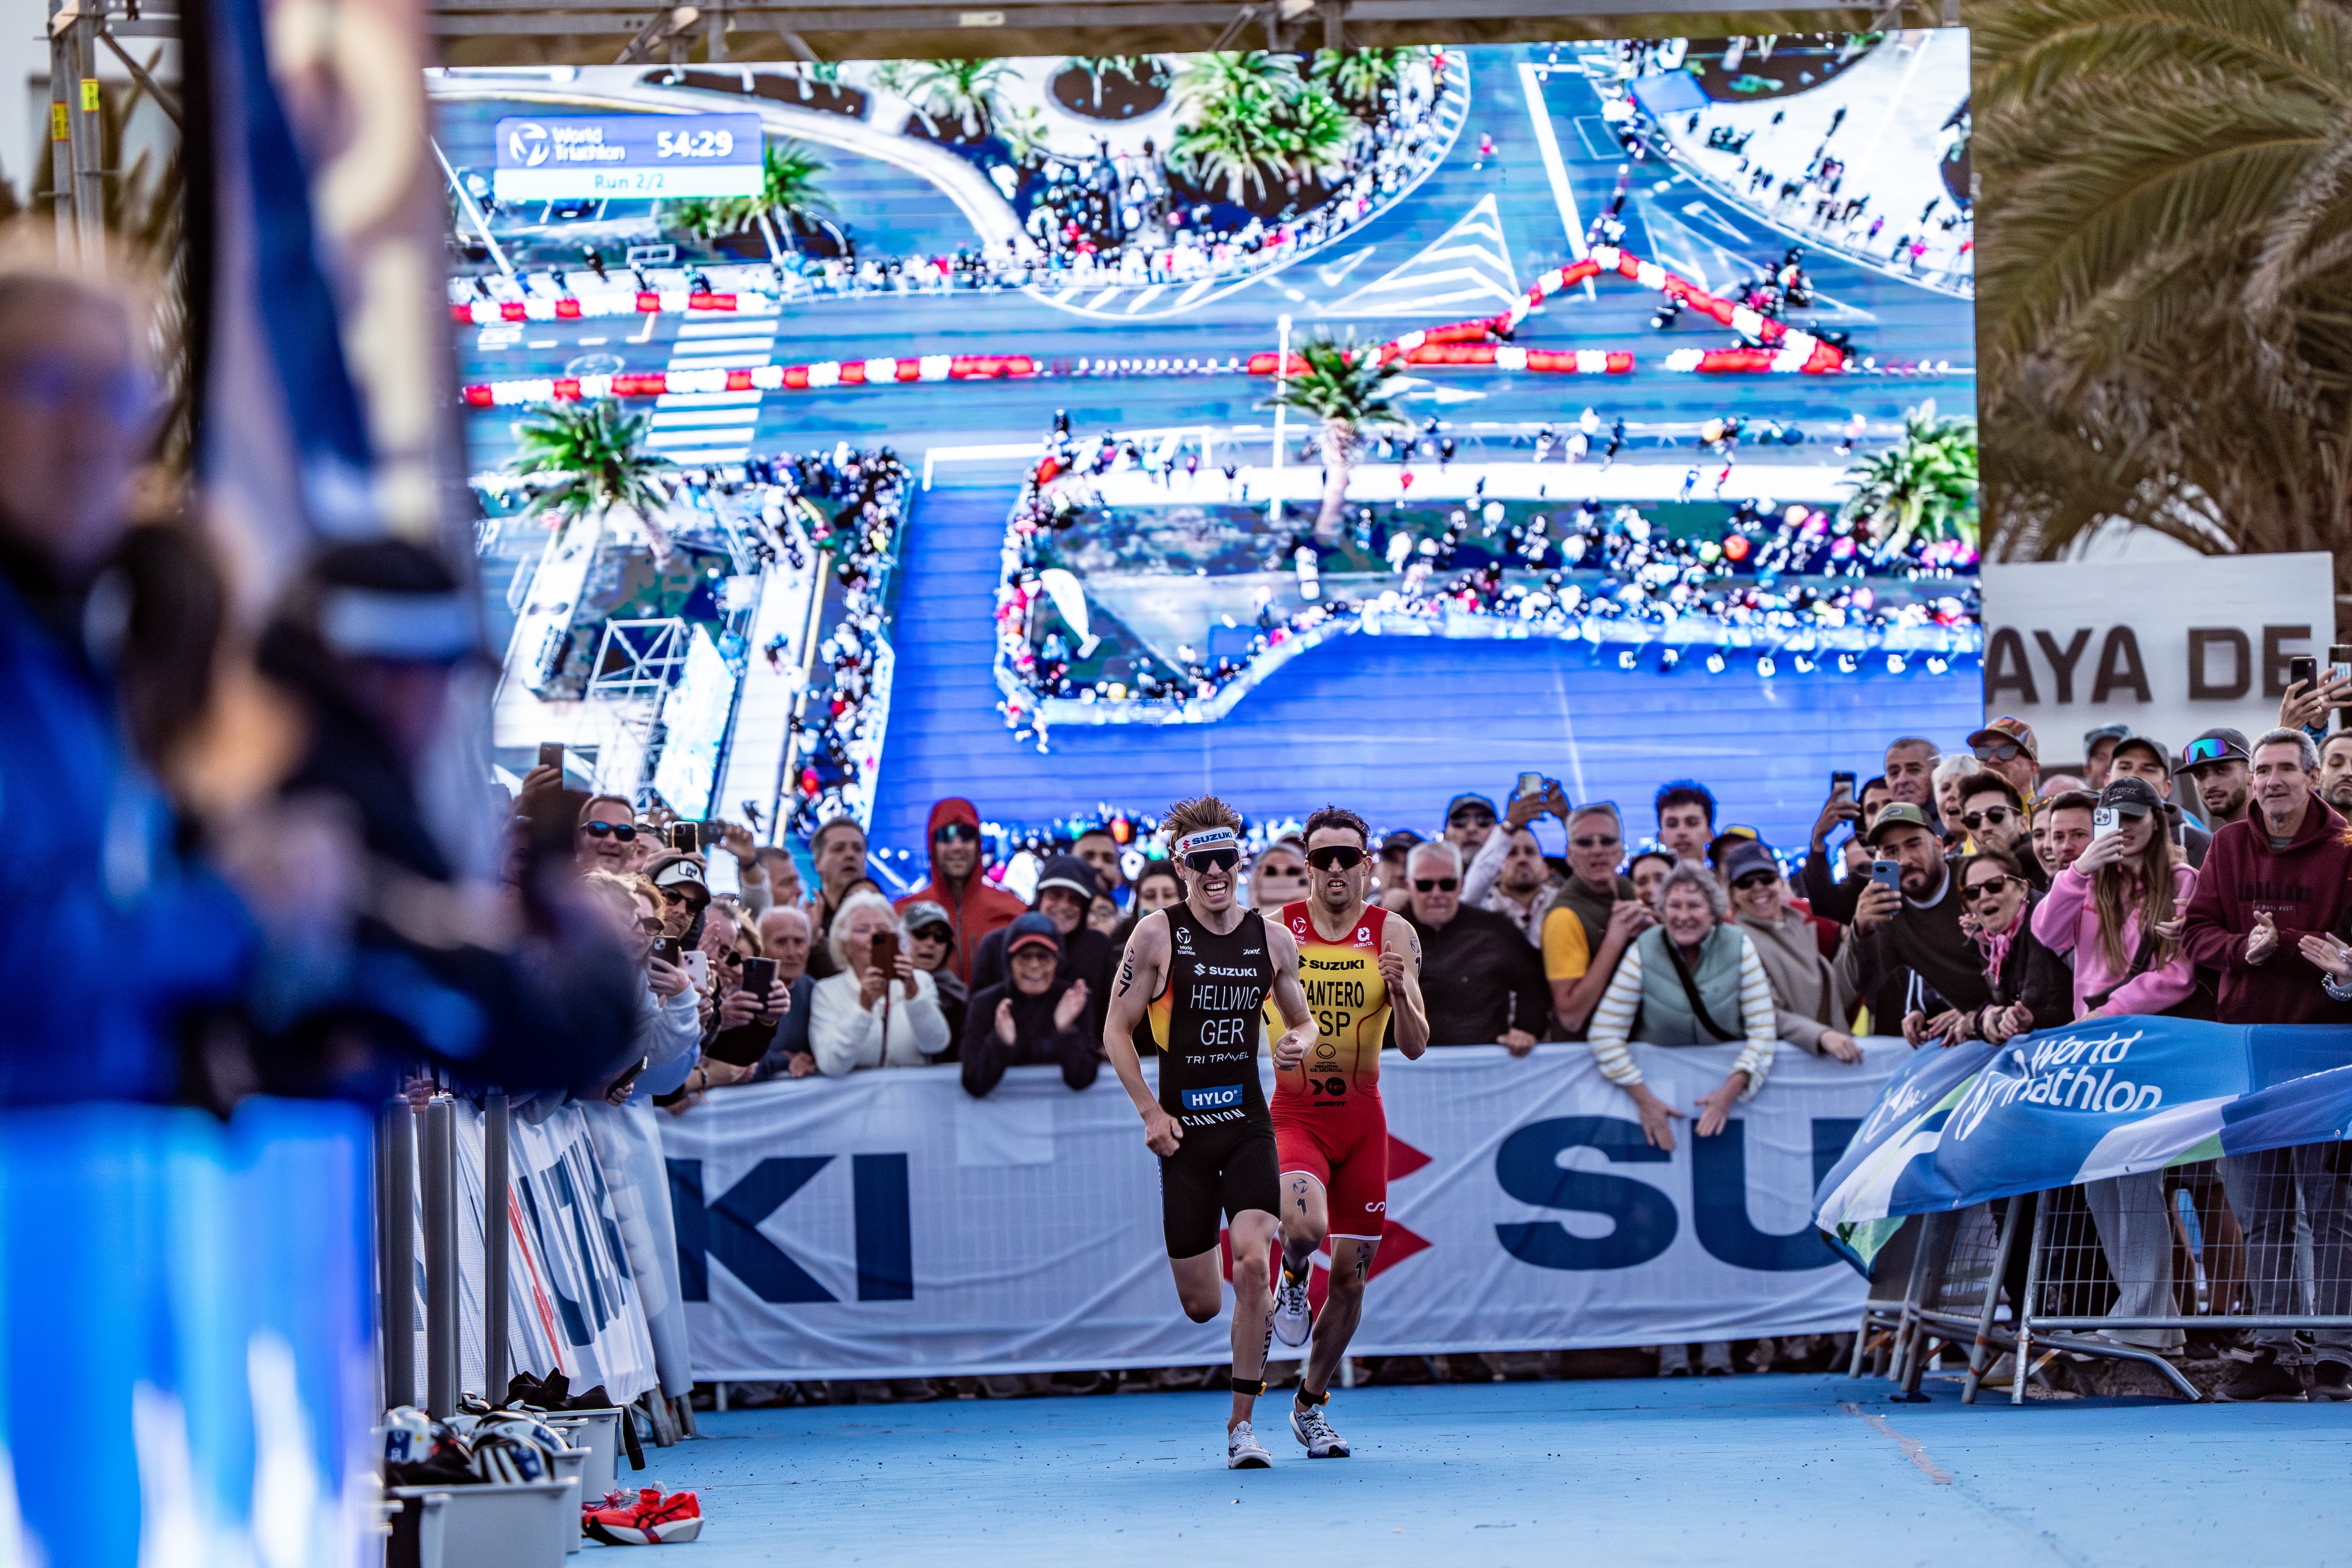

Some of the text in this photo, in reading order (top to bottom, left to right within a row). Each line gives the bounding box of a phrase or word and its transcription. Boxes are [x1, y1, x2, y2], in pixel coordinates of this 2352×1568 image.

[552, 127, 603, 144] World
[657, 130, 733, 158] 54:29
[556, 144, 626, 161] Triathlon
[595, 173, 664, 191] Run 2/2
[1985, 625, 2312, 704] AYA DE
[1192, 832, 1232, 844] SUZUKI
[1209, 966, 1257, 976] SUZUKI
[1309, 959, 1364, 970] SUZUKI
[1190, 984, 1260, 1010] HELLWIG
[1200, 1018, 1244, 1045] GER
[1310, 1010, 1351, 1036] SP
[1185, 1051, 1249, 1064] TRI TRAVEL
[2032, 1030, 2143, 1078] World
[1181, 1108, 1246, 1125] CANYON
[1496, 1115, 1864, 1272] SU
[1296, 1198, 1307, 1216] 1
[1355, 1260, 1364, 1279] 1
